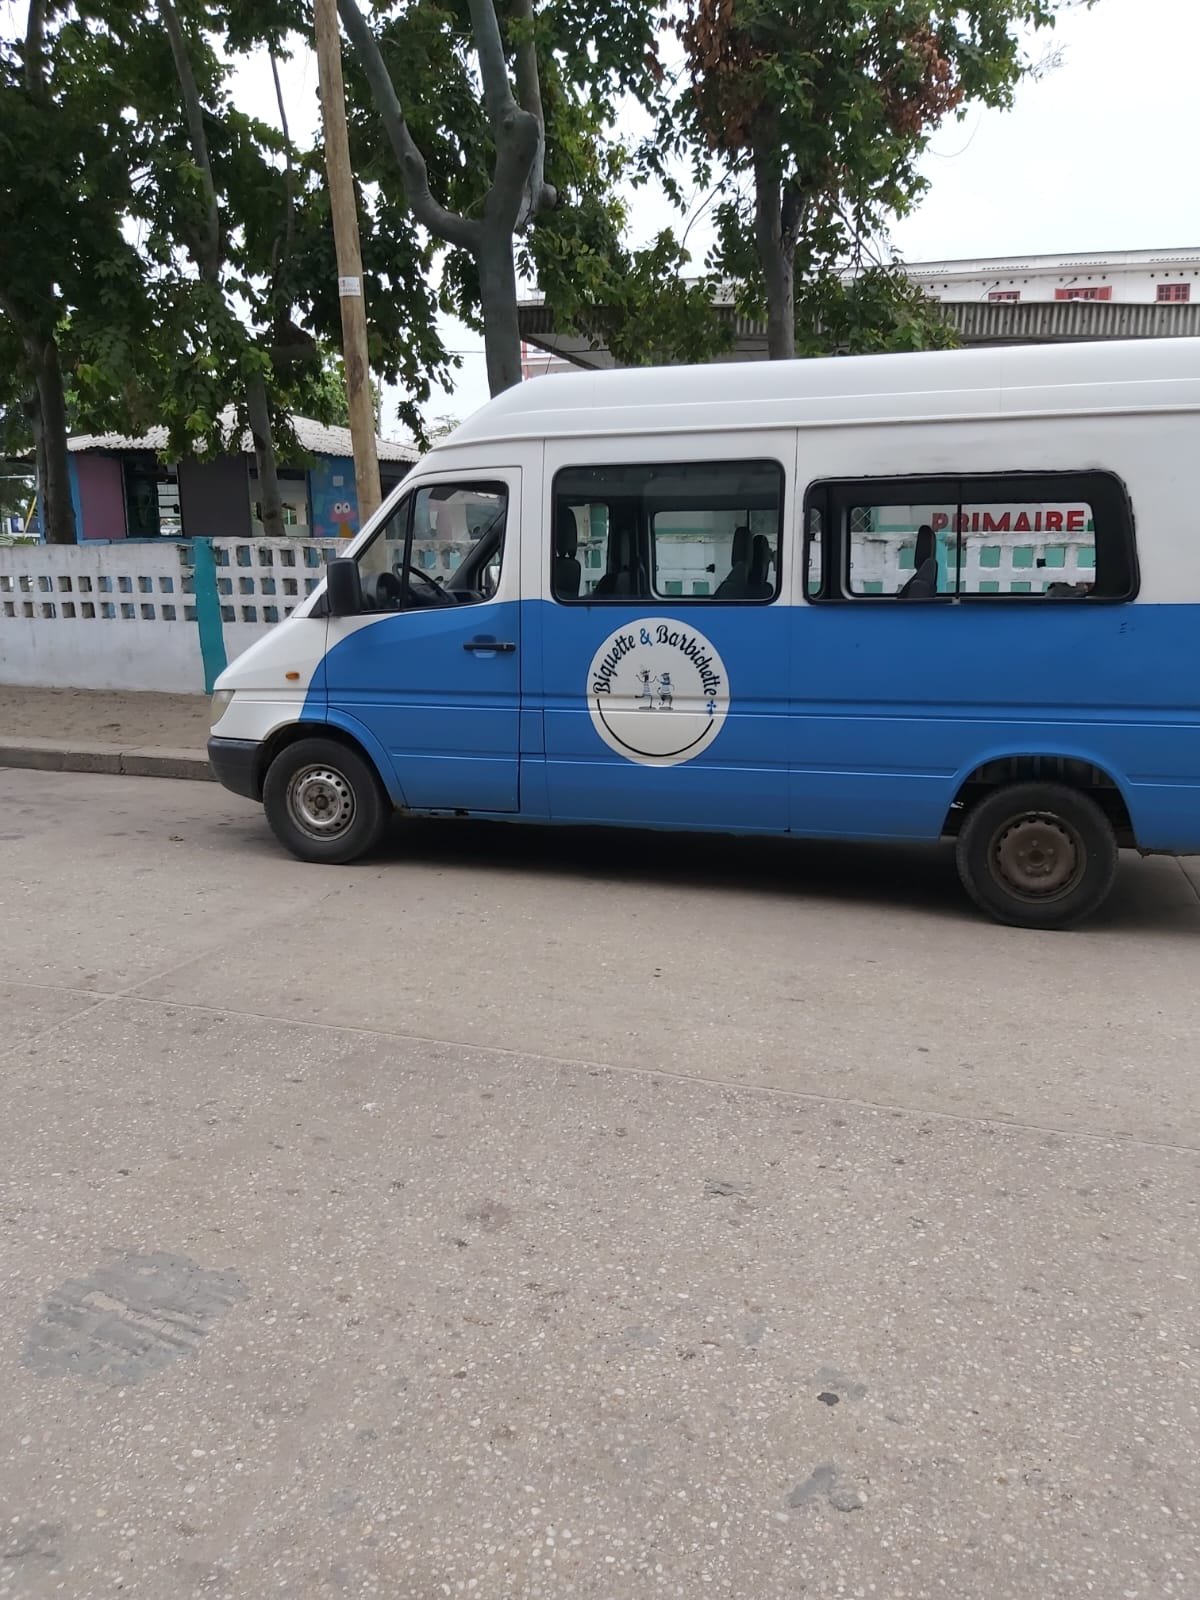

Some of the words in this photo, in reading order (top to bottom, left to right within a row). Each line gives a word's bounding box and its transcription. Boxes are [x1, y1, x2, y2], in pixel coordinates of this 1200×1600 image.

[932, 510, 1085, 532] PRIMAIRE
[593, 634, 636, 694] Biquette
[640, 627, 652, 646] &
[656, 624, 721, 696] Barbichette
